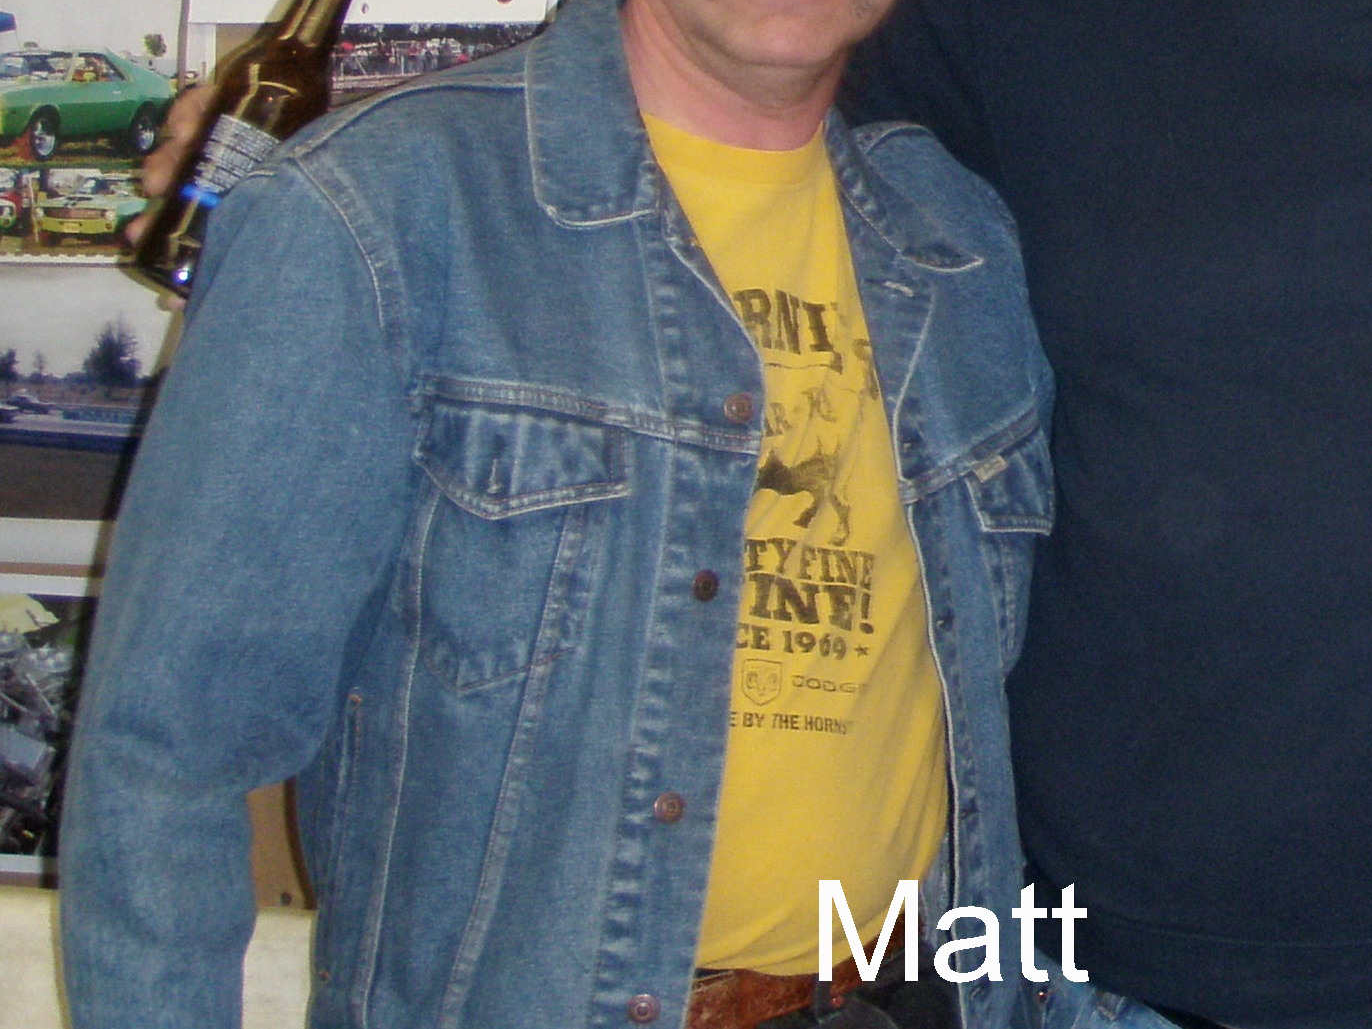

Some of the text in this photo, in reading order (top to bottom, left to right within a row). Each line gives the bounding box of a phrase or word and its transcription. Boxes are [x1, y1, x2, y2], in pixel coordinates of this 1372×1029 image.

[783, 630, 847, 660] 1969
[743, 712, 765, 728] BY
[772, 713, 800, 729] THE
